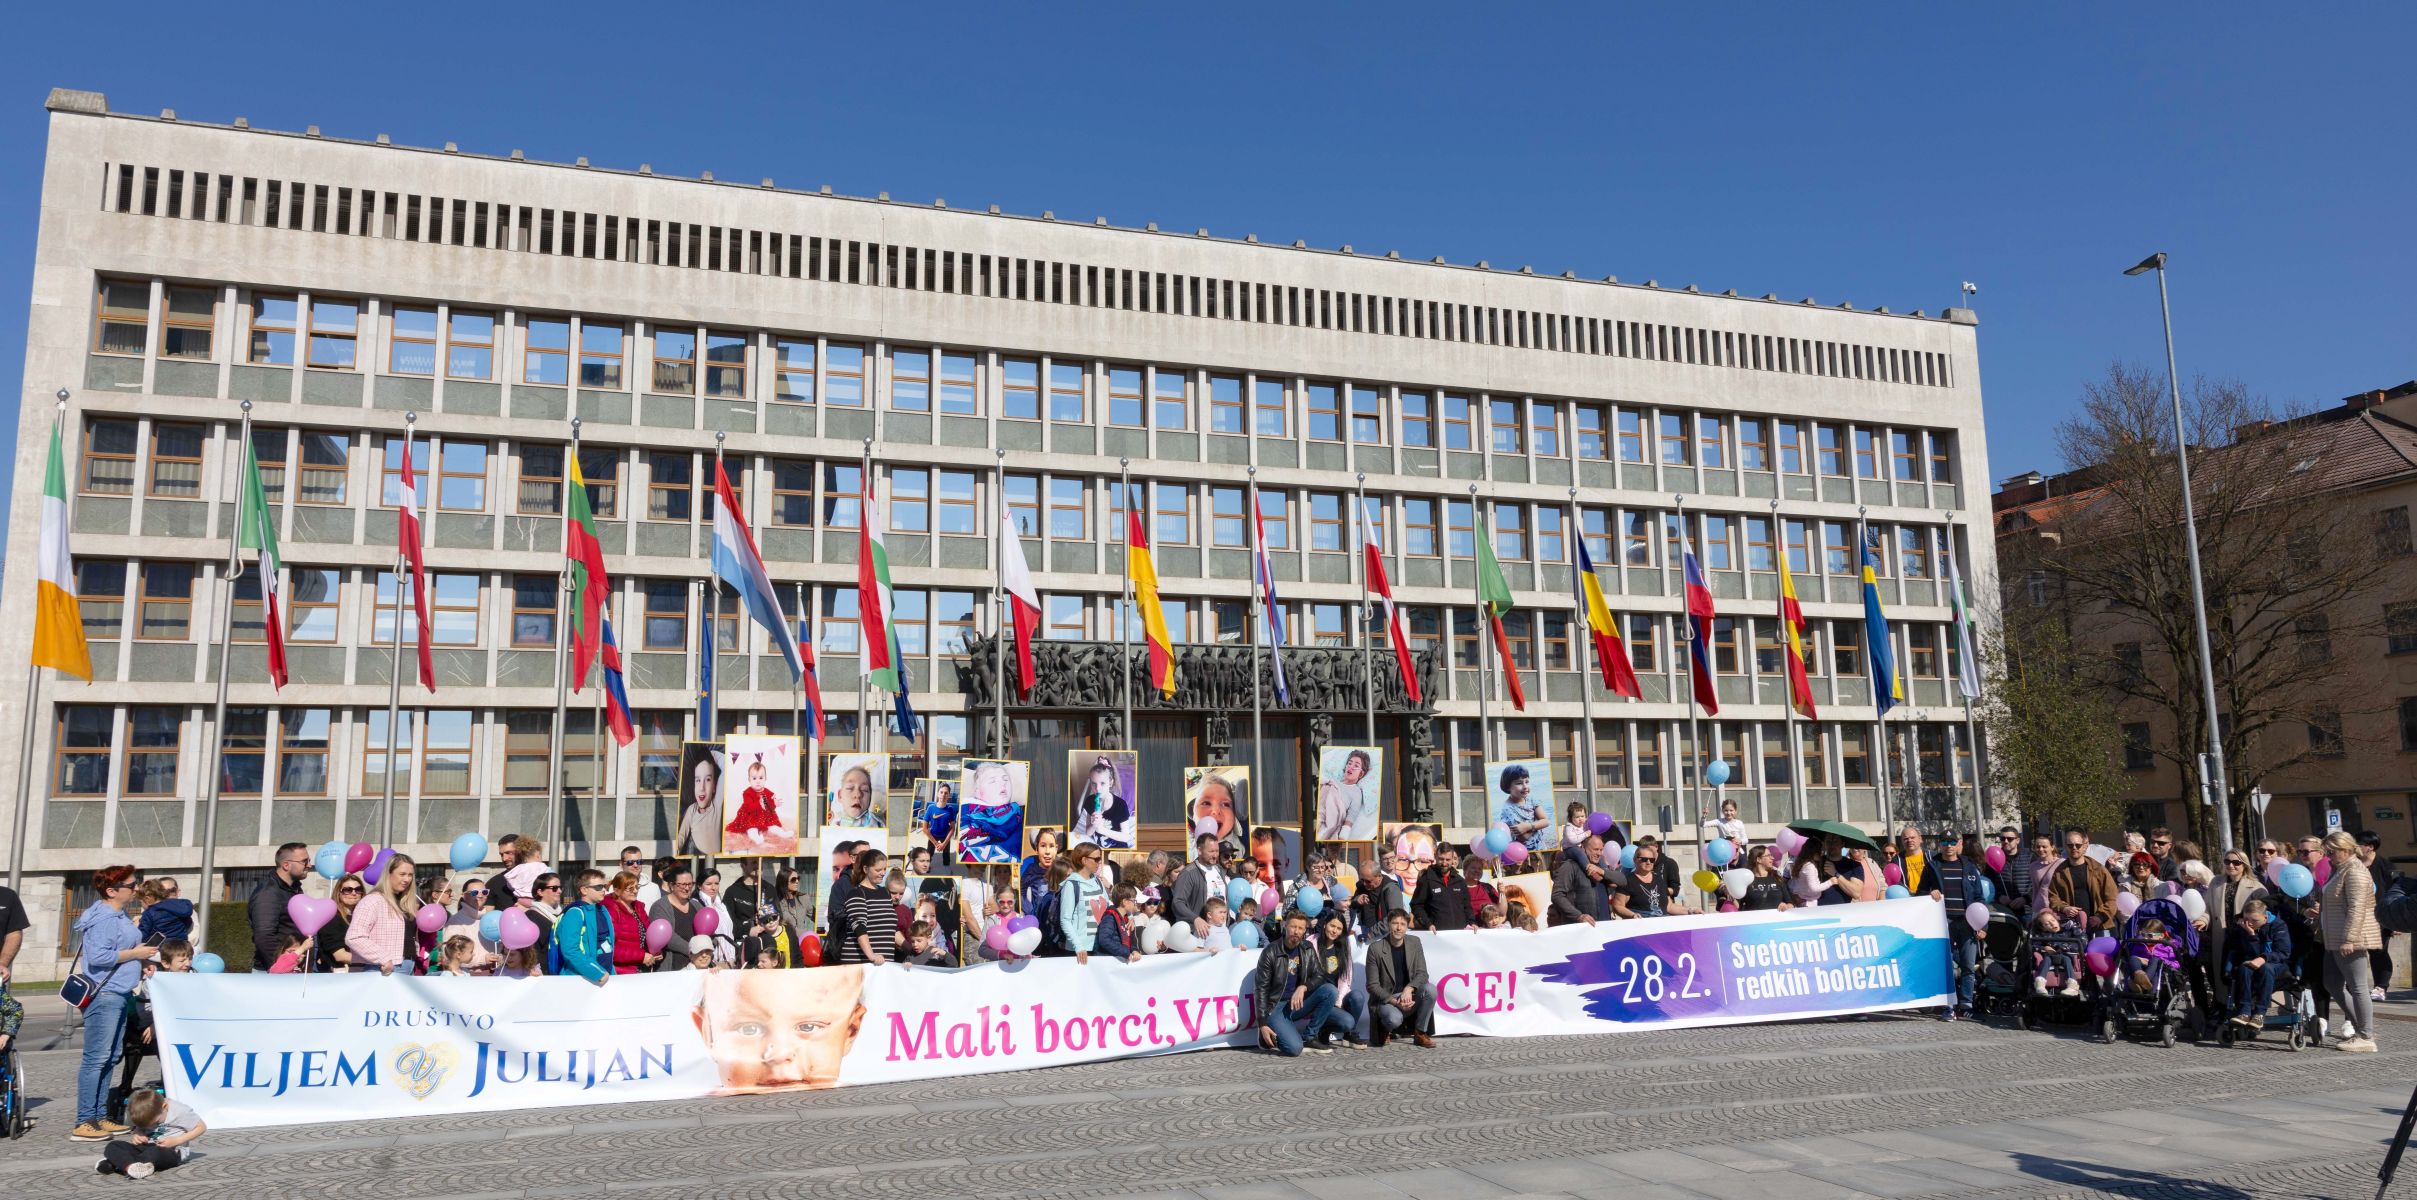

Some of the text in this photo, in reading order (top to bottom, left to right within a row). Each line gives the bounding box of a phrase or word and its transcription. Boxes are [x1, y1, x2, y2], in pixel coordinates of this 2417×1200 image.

[1731, 932, 1879, 969] Svetovni dan
[1620, 952, 1711, 1004] 28.2.
[1736, 959, 1901, 1001] redkih bolezni
[363, 1006, 495, 1030] DRUŠTVO
[885, 1003, 1017, 1062] Mali
[1030, 996, 1176, 1052] borci,
[171, 1041, 675, 1098] VILJEM JULIJAN
